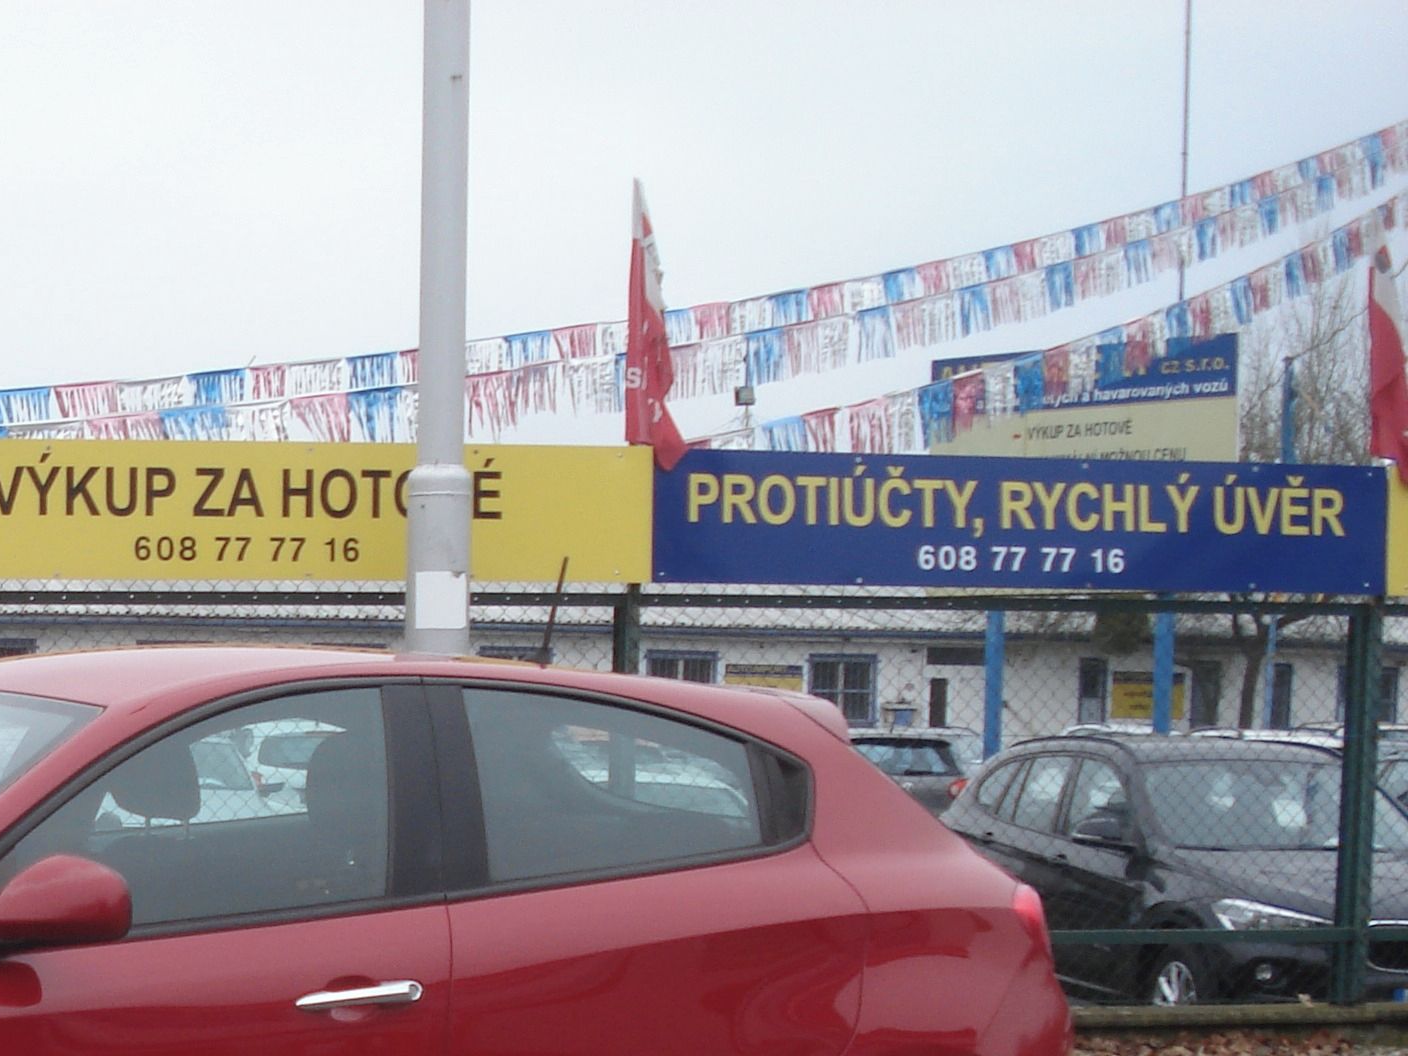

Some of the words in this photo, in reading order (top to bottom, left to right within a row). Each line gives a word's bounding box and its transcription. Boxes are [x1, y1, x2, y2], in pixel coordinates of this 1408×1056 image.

[1067, 423, 1082, 438] ZA
[193, 467, 264, 518] ZA
[282, 458, 503, 520] HOTÉ
[688, 464, 984, 538] PROTIÚČTY,
[1000, 472, 1199, 533] RYCHLÝ
[1213, 473, 1345, 537] ÚVĚR
[134, 536, 197, 561] 608
[214, 537, 251, 562] 77
[270, 537, 306, 562] 77
[325, 538, 360, 562] 16
[917, 545, 977, 571] 608
[991, 546, 1027, 572] 77
[1040, 547, 1076, 573] 77
[1091, 548, 1125, 574] 16
